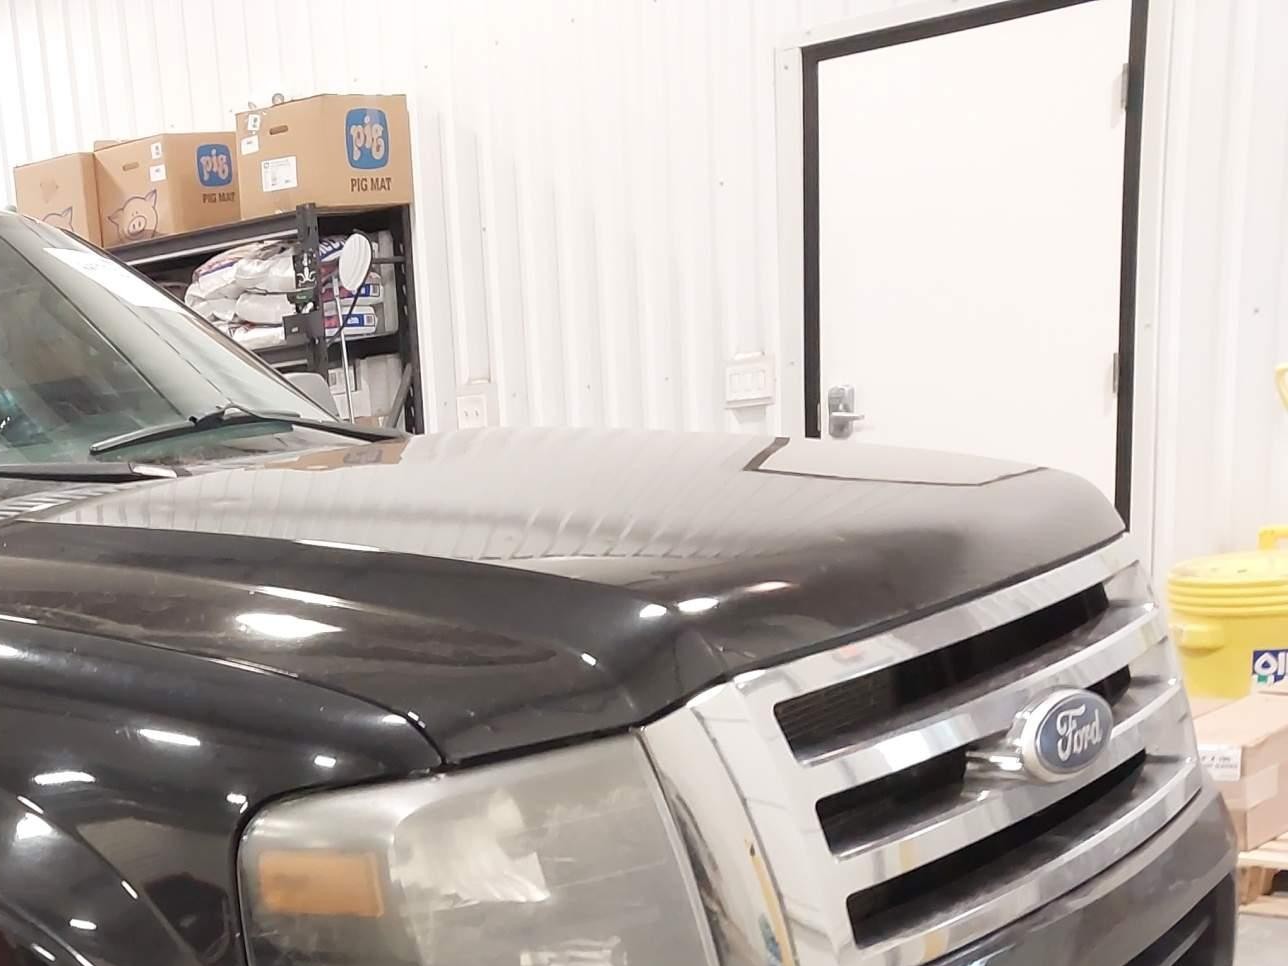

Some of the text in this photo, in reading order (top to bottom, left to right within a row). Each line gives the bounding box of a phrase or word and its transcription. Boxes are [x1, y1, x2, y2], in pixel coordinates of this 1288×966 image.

[351, 115, 385, 161] pig
[200, 148, 229, 181] pig
[202, 193, 217, 203] PIG
[350, 177, 392, 192] PIG MAT
[1056, 703, 1103, 761] Ford
